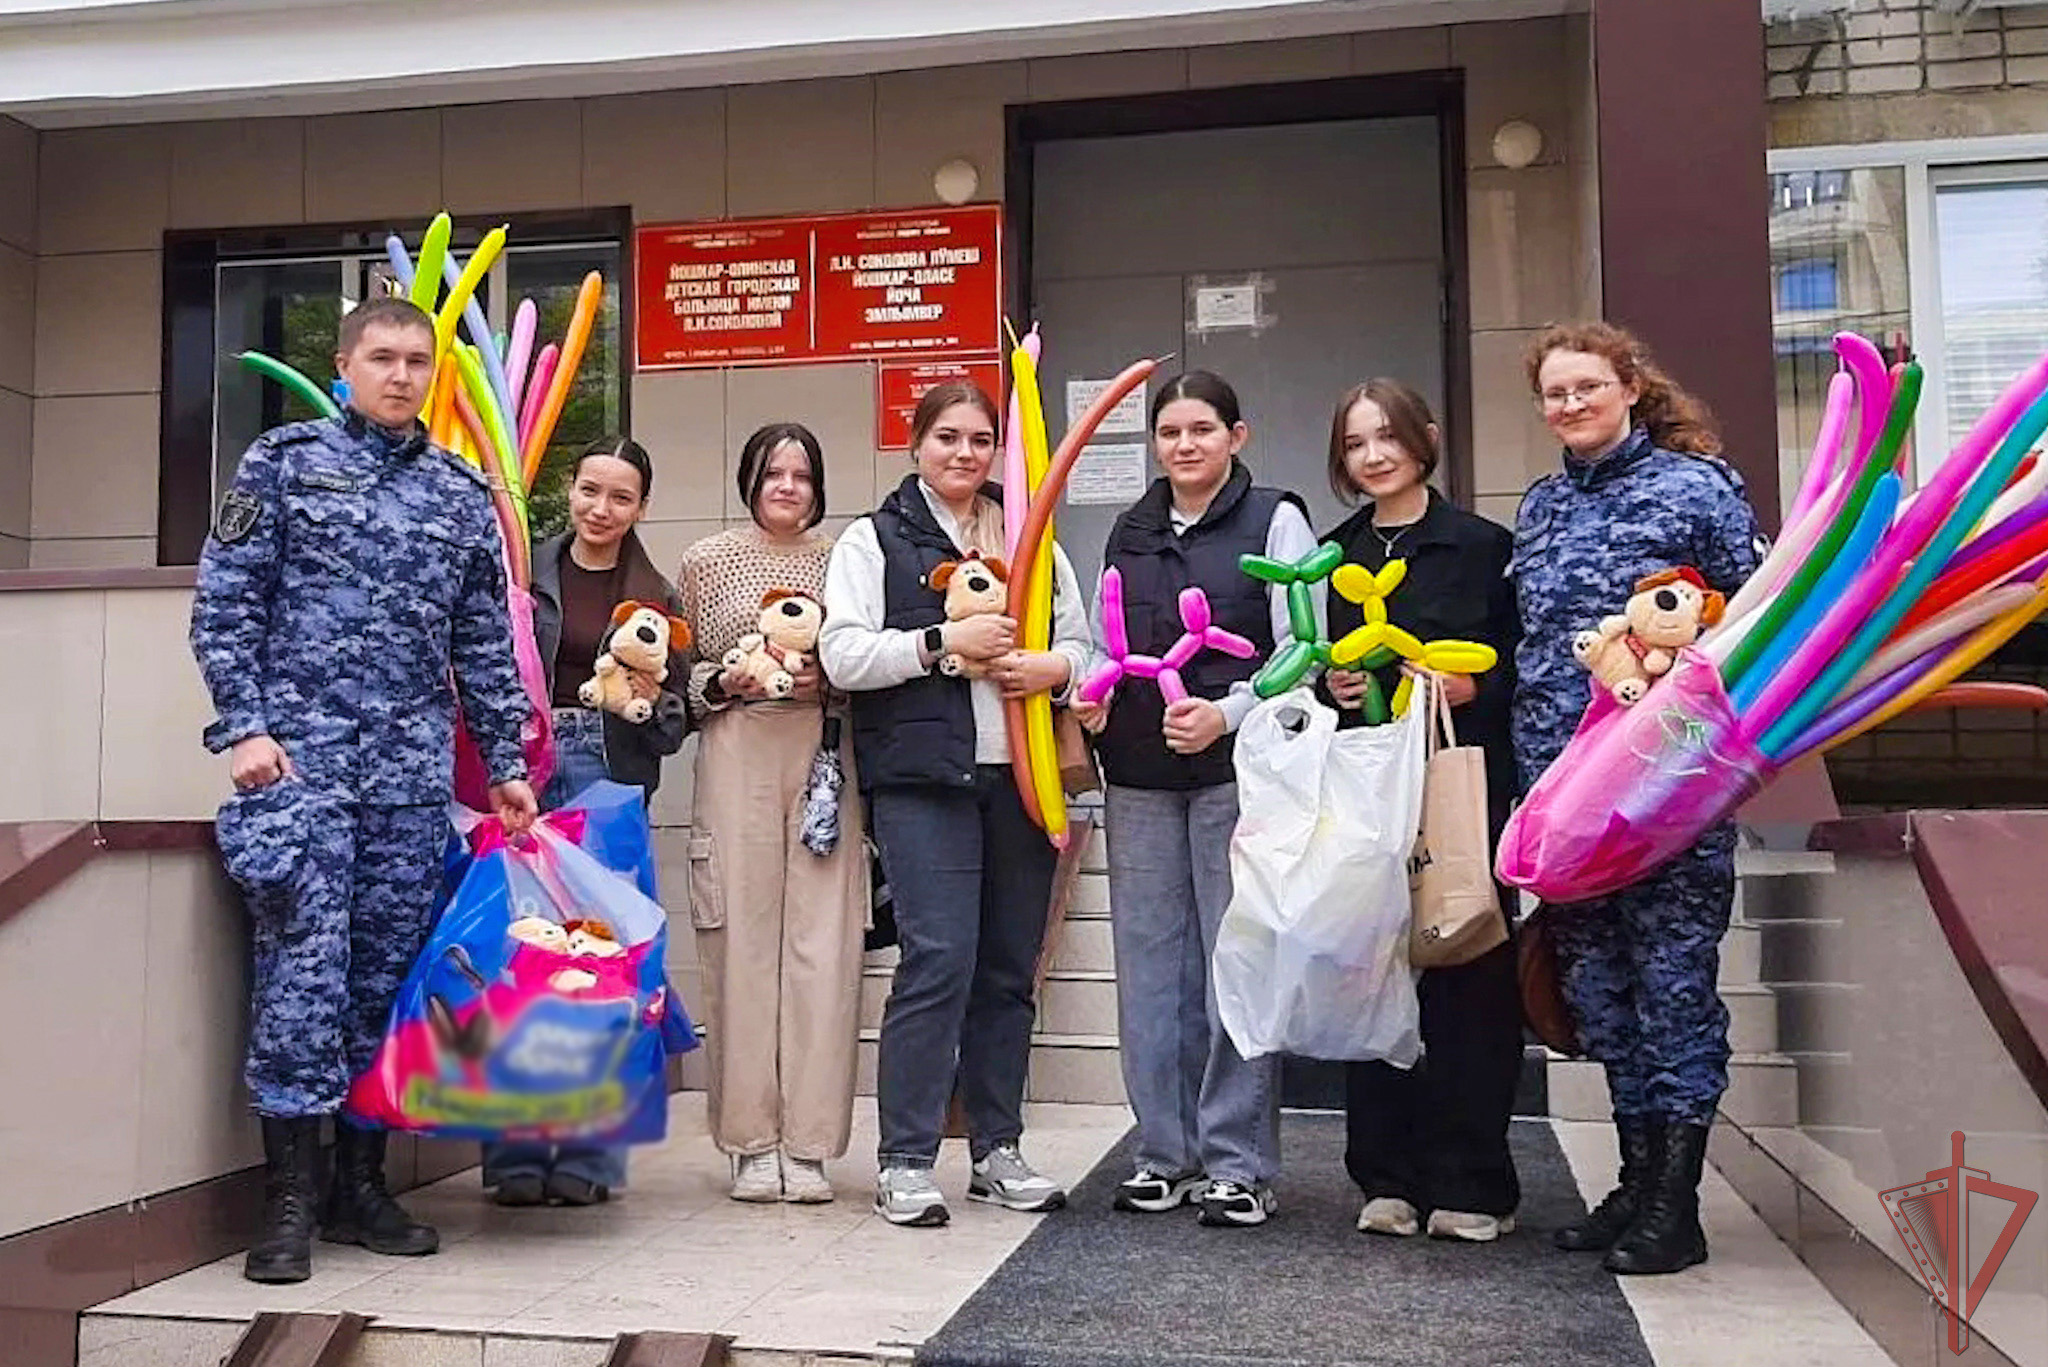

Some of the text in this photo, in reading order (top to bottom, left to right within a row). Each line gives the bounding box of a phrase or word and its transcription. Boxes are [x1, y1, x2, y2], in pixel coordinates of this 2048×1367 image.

[665, 276, 800, 300] ДЕТСКАЯ ГОРОДСКАЯ
[674, 297, 740, 315] БОЛЬНИЦА
